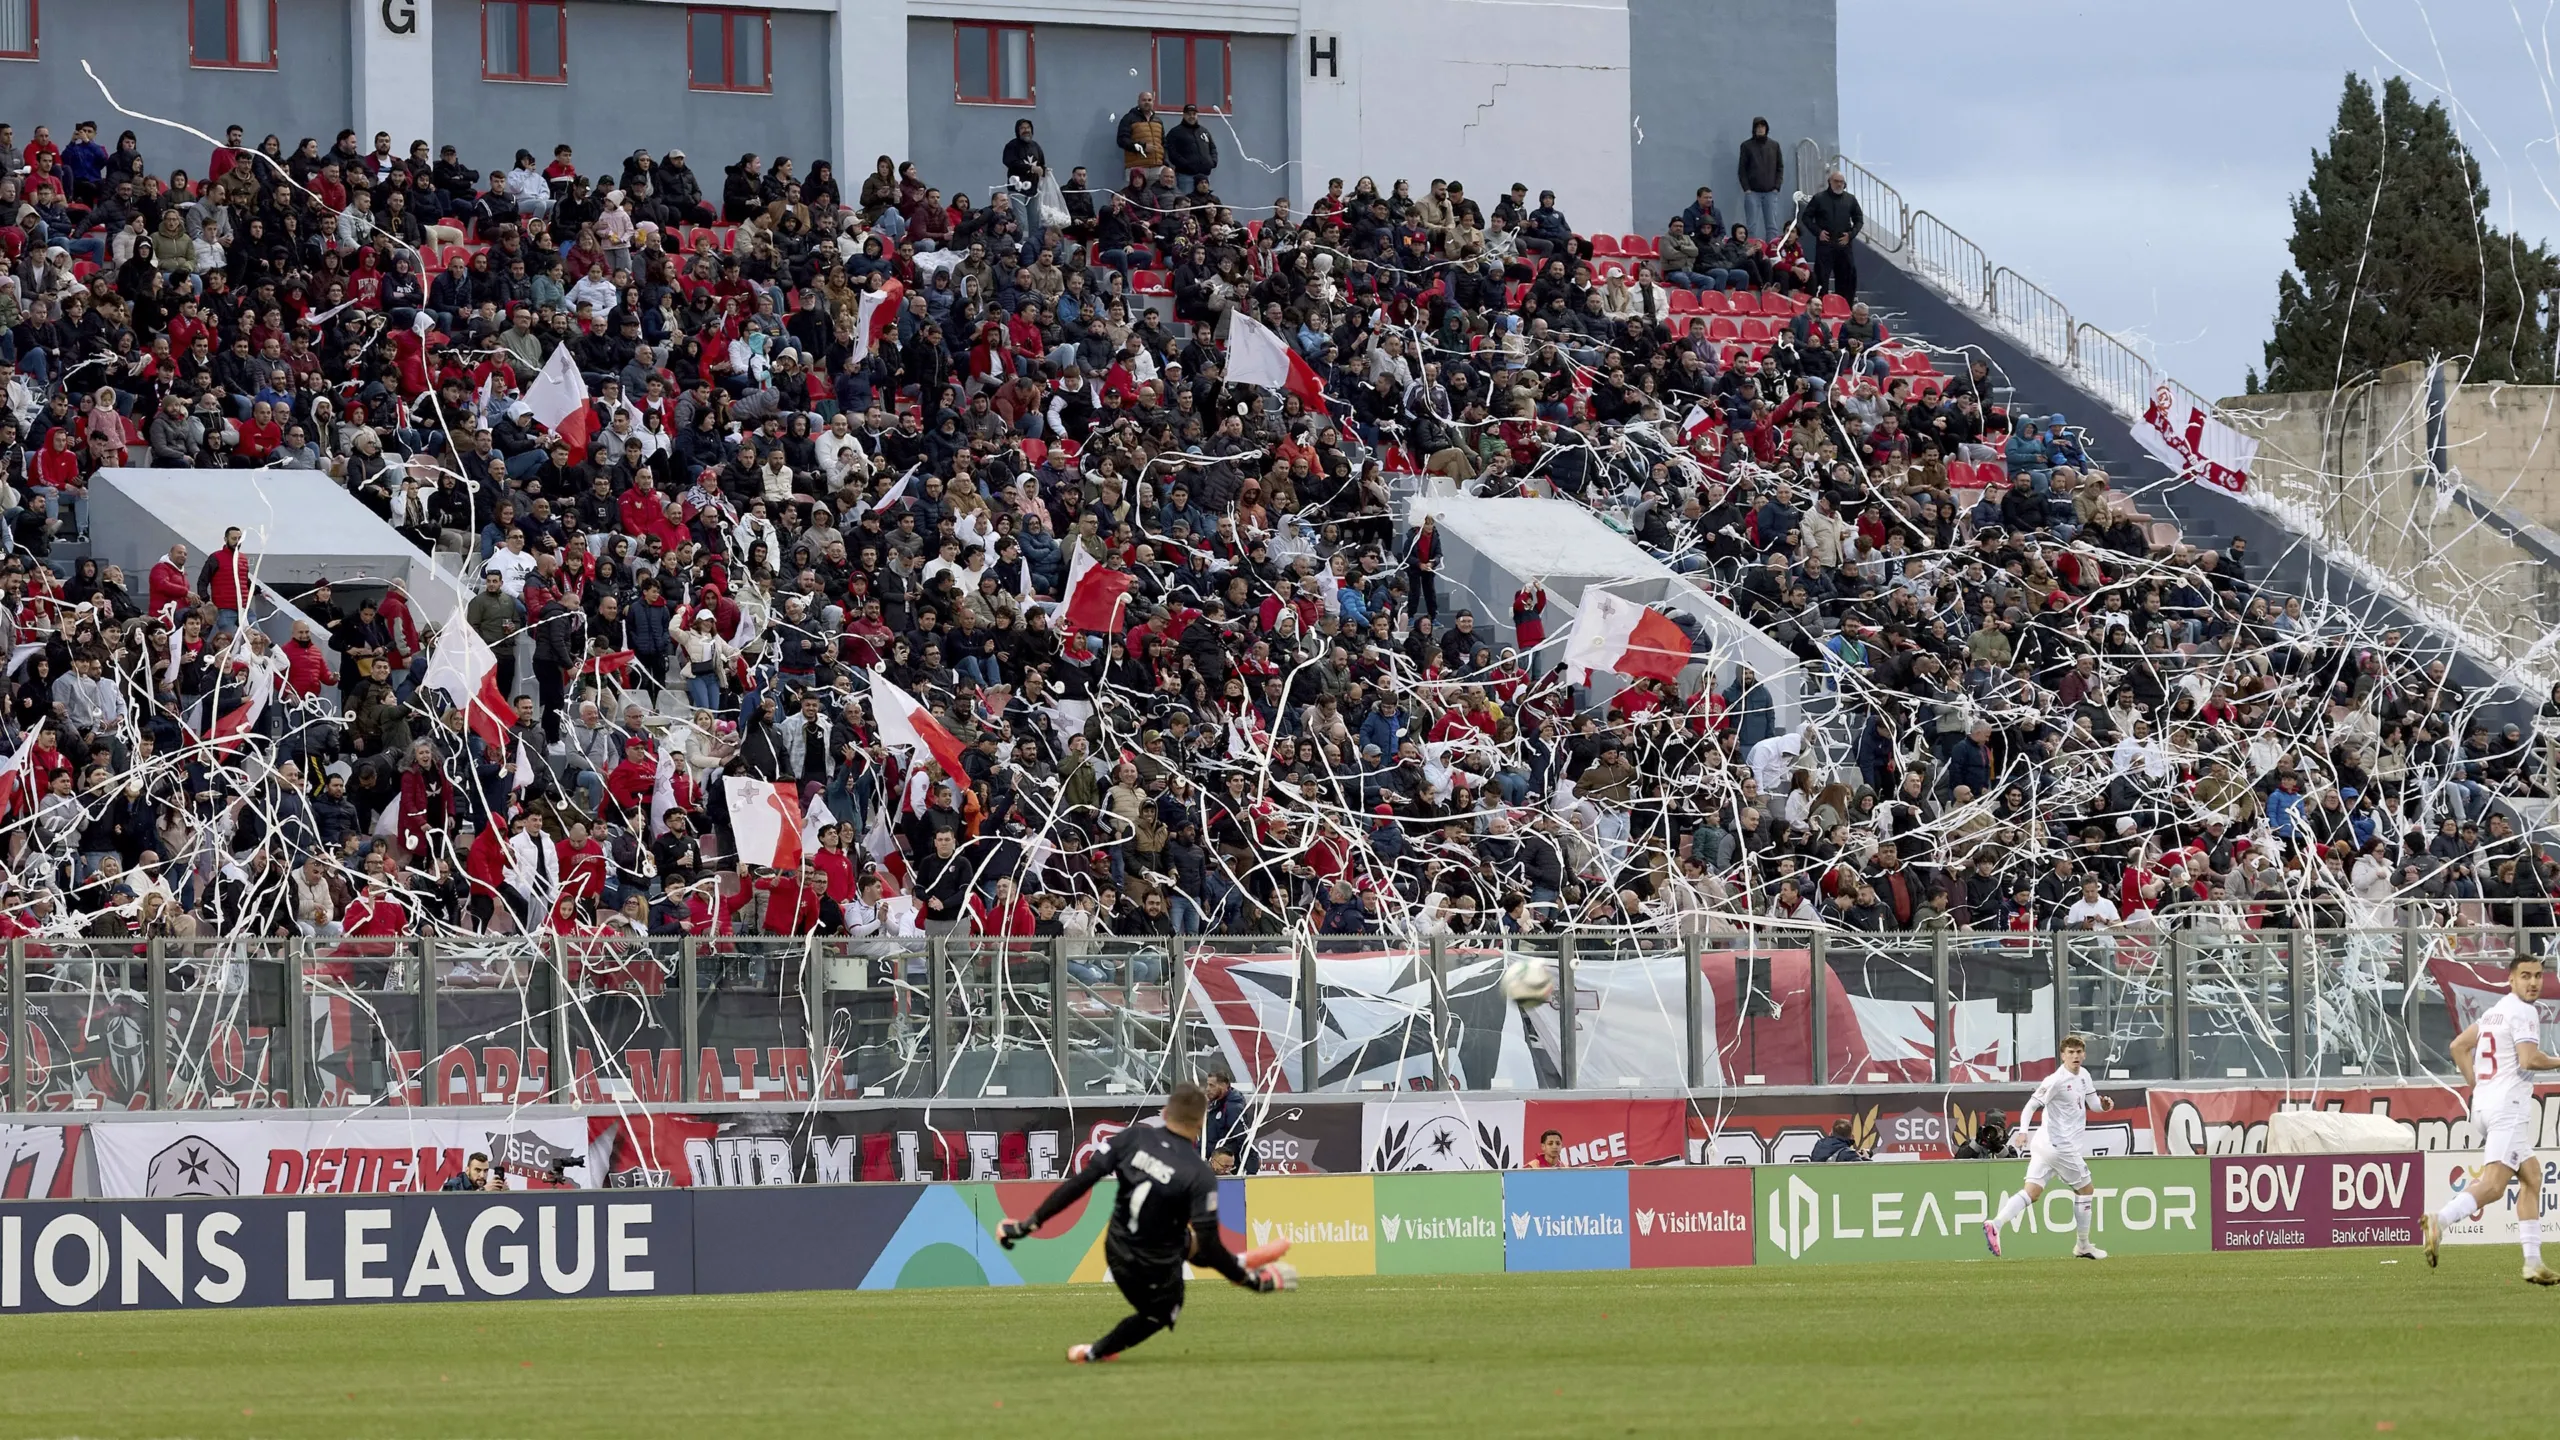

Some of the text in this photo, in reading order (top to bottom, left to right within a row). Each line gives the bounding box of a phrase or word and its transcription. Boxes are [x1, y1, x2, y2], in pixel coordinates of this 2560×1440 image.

[382, 0, 416, 34] G
[1310, 36, 1337, 77] H
[2474, 1031, 2498, 1080] 3
[624, 1046, 850, 1105] MALTA
[1894, 1117, 1941, 1141] SEC
[507, 1138, 550, 1168] SEC
[1258, 1139, 1299, 1160] SEC
[1898, 1143, 1938, 1152] MALTA
[508, 1165, 548, 1180] MALTA
[2226, 1164, 2306, 1213] BOV
[2332, 1162, 2411, 1211] BOV
[1126, 1180, 1153, 1234] 1
[1832, 1185, 2197, 1239] LEAPMOTOR
[1275, 1219, 1369, 1244] VisitMalta
[1404, 1215, 1497, 1240] VisitMalta
[1533, 1213, 1624, 1237] VisitMalta
[1657, 1209, 1747, 1233] VisitMalta
[2448, 1225, 2484, 1234] VILLAGE
[2225, 1229, 2305, 1246] Bank of Valletta
[2332, 1227, 2411, 1243] Bank of Valletta
[1, 1203, 656, 1308] IONS LEAGUE
